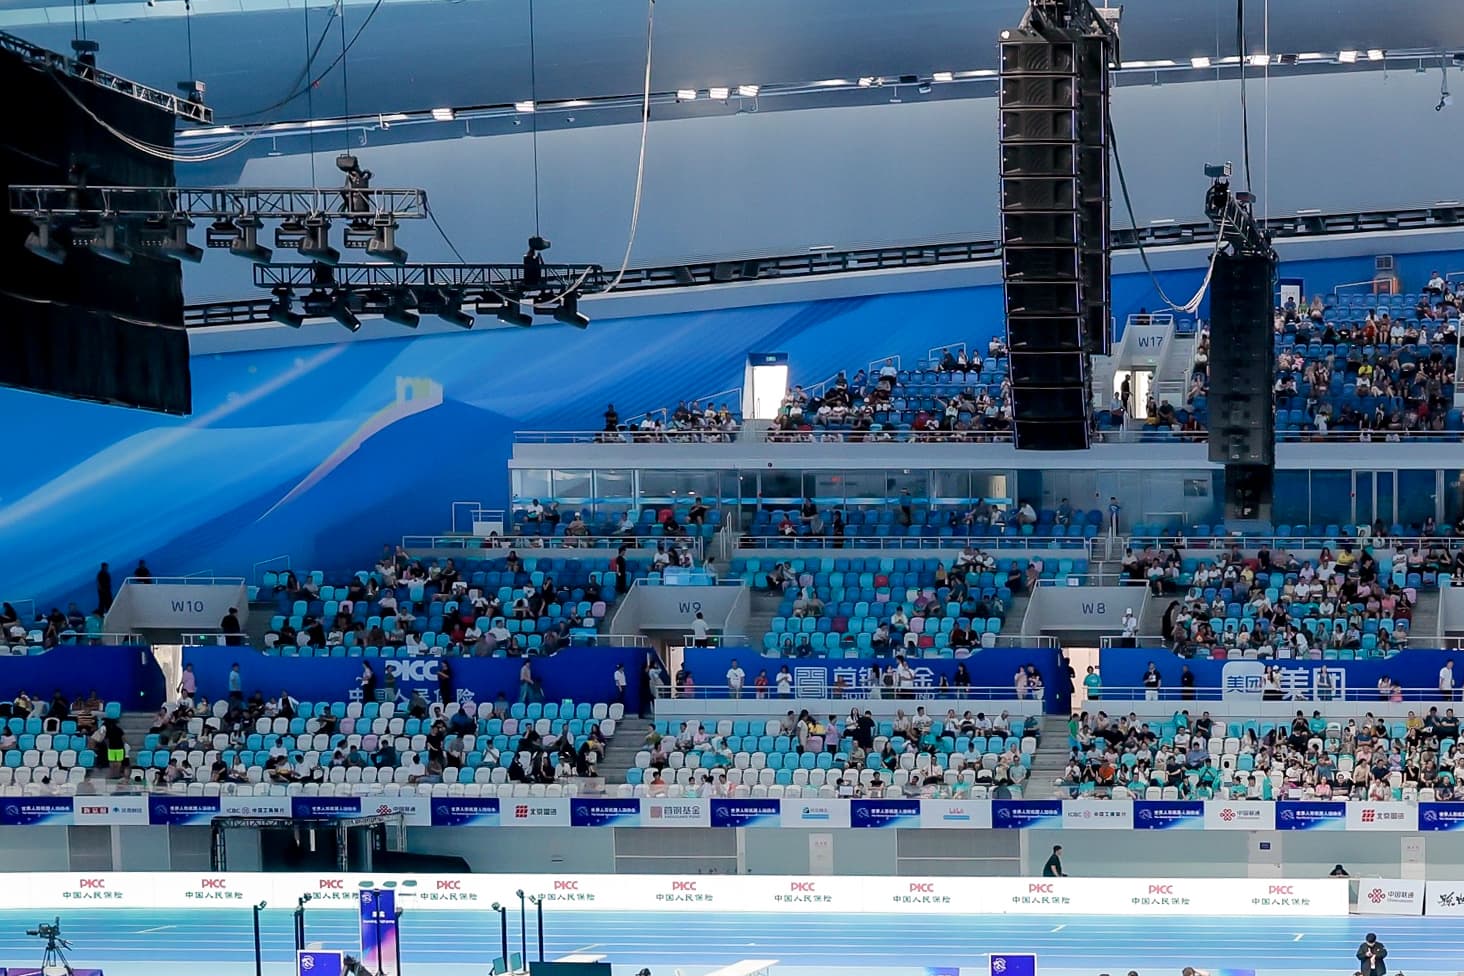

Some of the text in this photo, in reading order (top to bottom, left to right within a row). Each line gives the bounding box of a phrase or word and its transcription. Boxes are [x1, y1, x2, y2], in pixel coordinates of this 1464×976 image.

[1138, 336, 1163, 347] W17
[171, 600, 204, 613] W10
[679, 602, 702, 613] W9
[1082, 602, 1106, 614] W8
[385, 660, 439, 681] PICC
[1280, 667, 1346, 701] 美团
[80, 879, 105, 889] PICC
[201, 879, 226, 889] PICC
[319, 879, 344, 889] PICC
[436, 880, 461, 890] PICC
[554, 880, 579, 890] PICC
[672, 881, 697, 891] PICC
[790, 882, 816, 891] PICC
[909, 882, 934, 892] PICC
[1028, 883, 1054, 893] PICC
[62, 890, 123, 899] 中国人民保险
[1148, 885, 1174, 894] PICC
[1268, 885, 1294, 895] PICC
[185, 891, 243, 899] 中国人民保险
[420, 892, 478, 901] 中国人民保险
[537, 893, 595, 901] 中国人民保险
[656, 893, 713, 902] 中国人民保险
[774, 894, 832, 903] 中国人民保险
[893, 895, 951, 903] 中国人民保险
[1012, 896, 1070, 904] 中国人民保险
[1387, 891, 1415, 899] 中国联通
[1131, 896, 1190, 905] 中国人民保险
[1251, 897, 1311, 906] 中国人民保险
